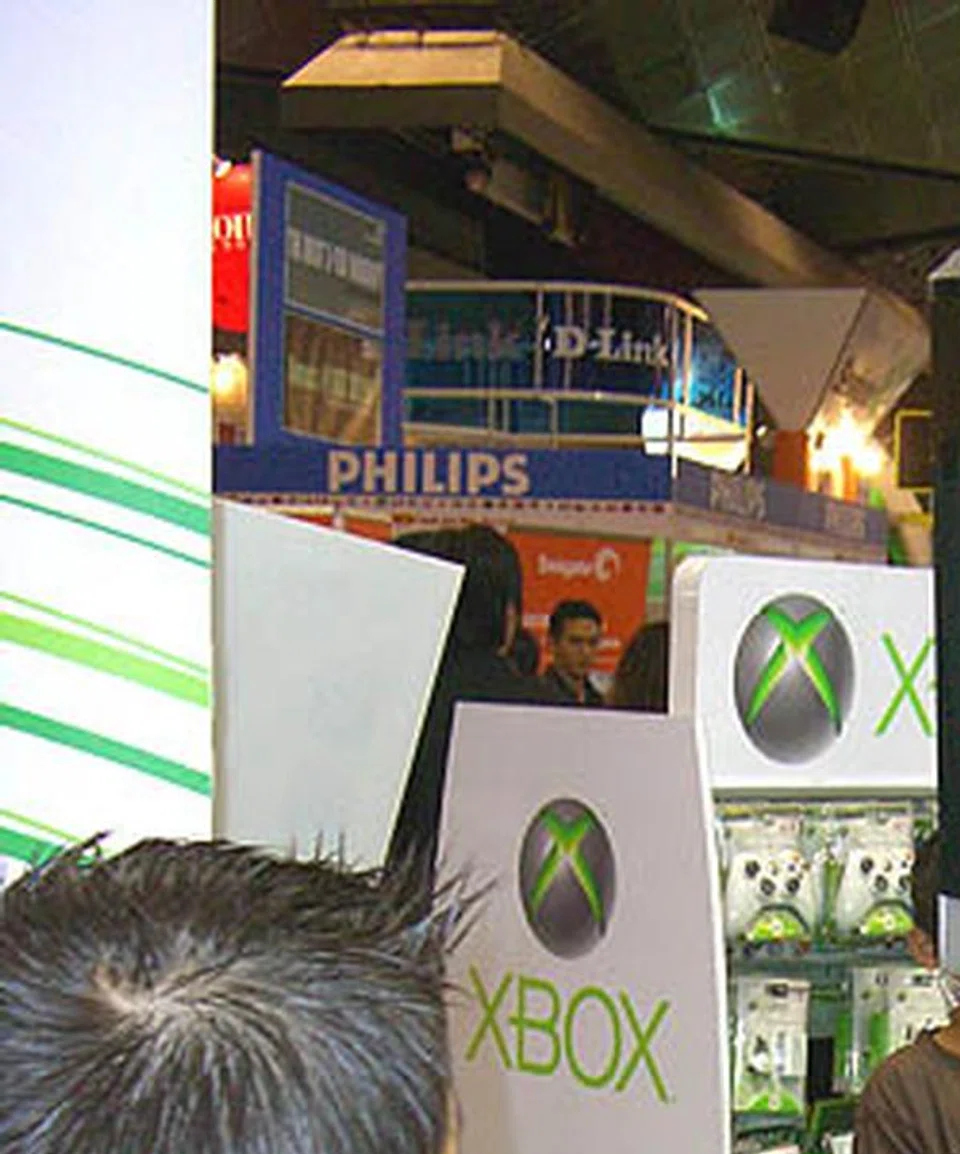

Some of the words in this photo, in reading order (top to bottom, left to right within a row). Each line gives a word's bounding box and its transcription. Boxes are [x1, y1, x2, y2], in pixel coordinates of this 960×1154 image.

[552, 325, 668, 368] D-Link
[328, 450, 530, 496] PHILIPS
[464, 964, 671, 1105] XBOX
